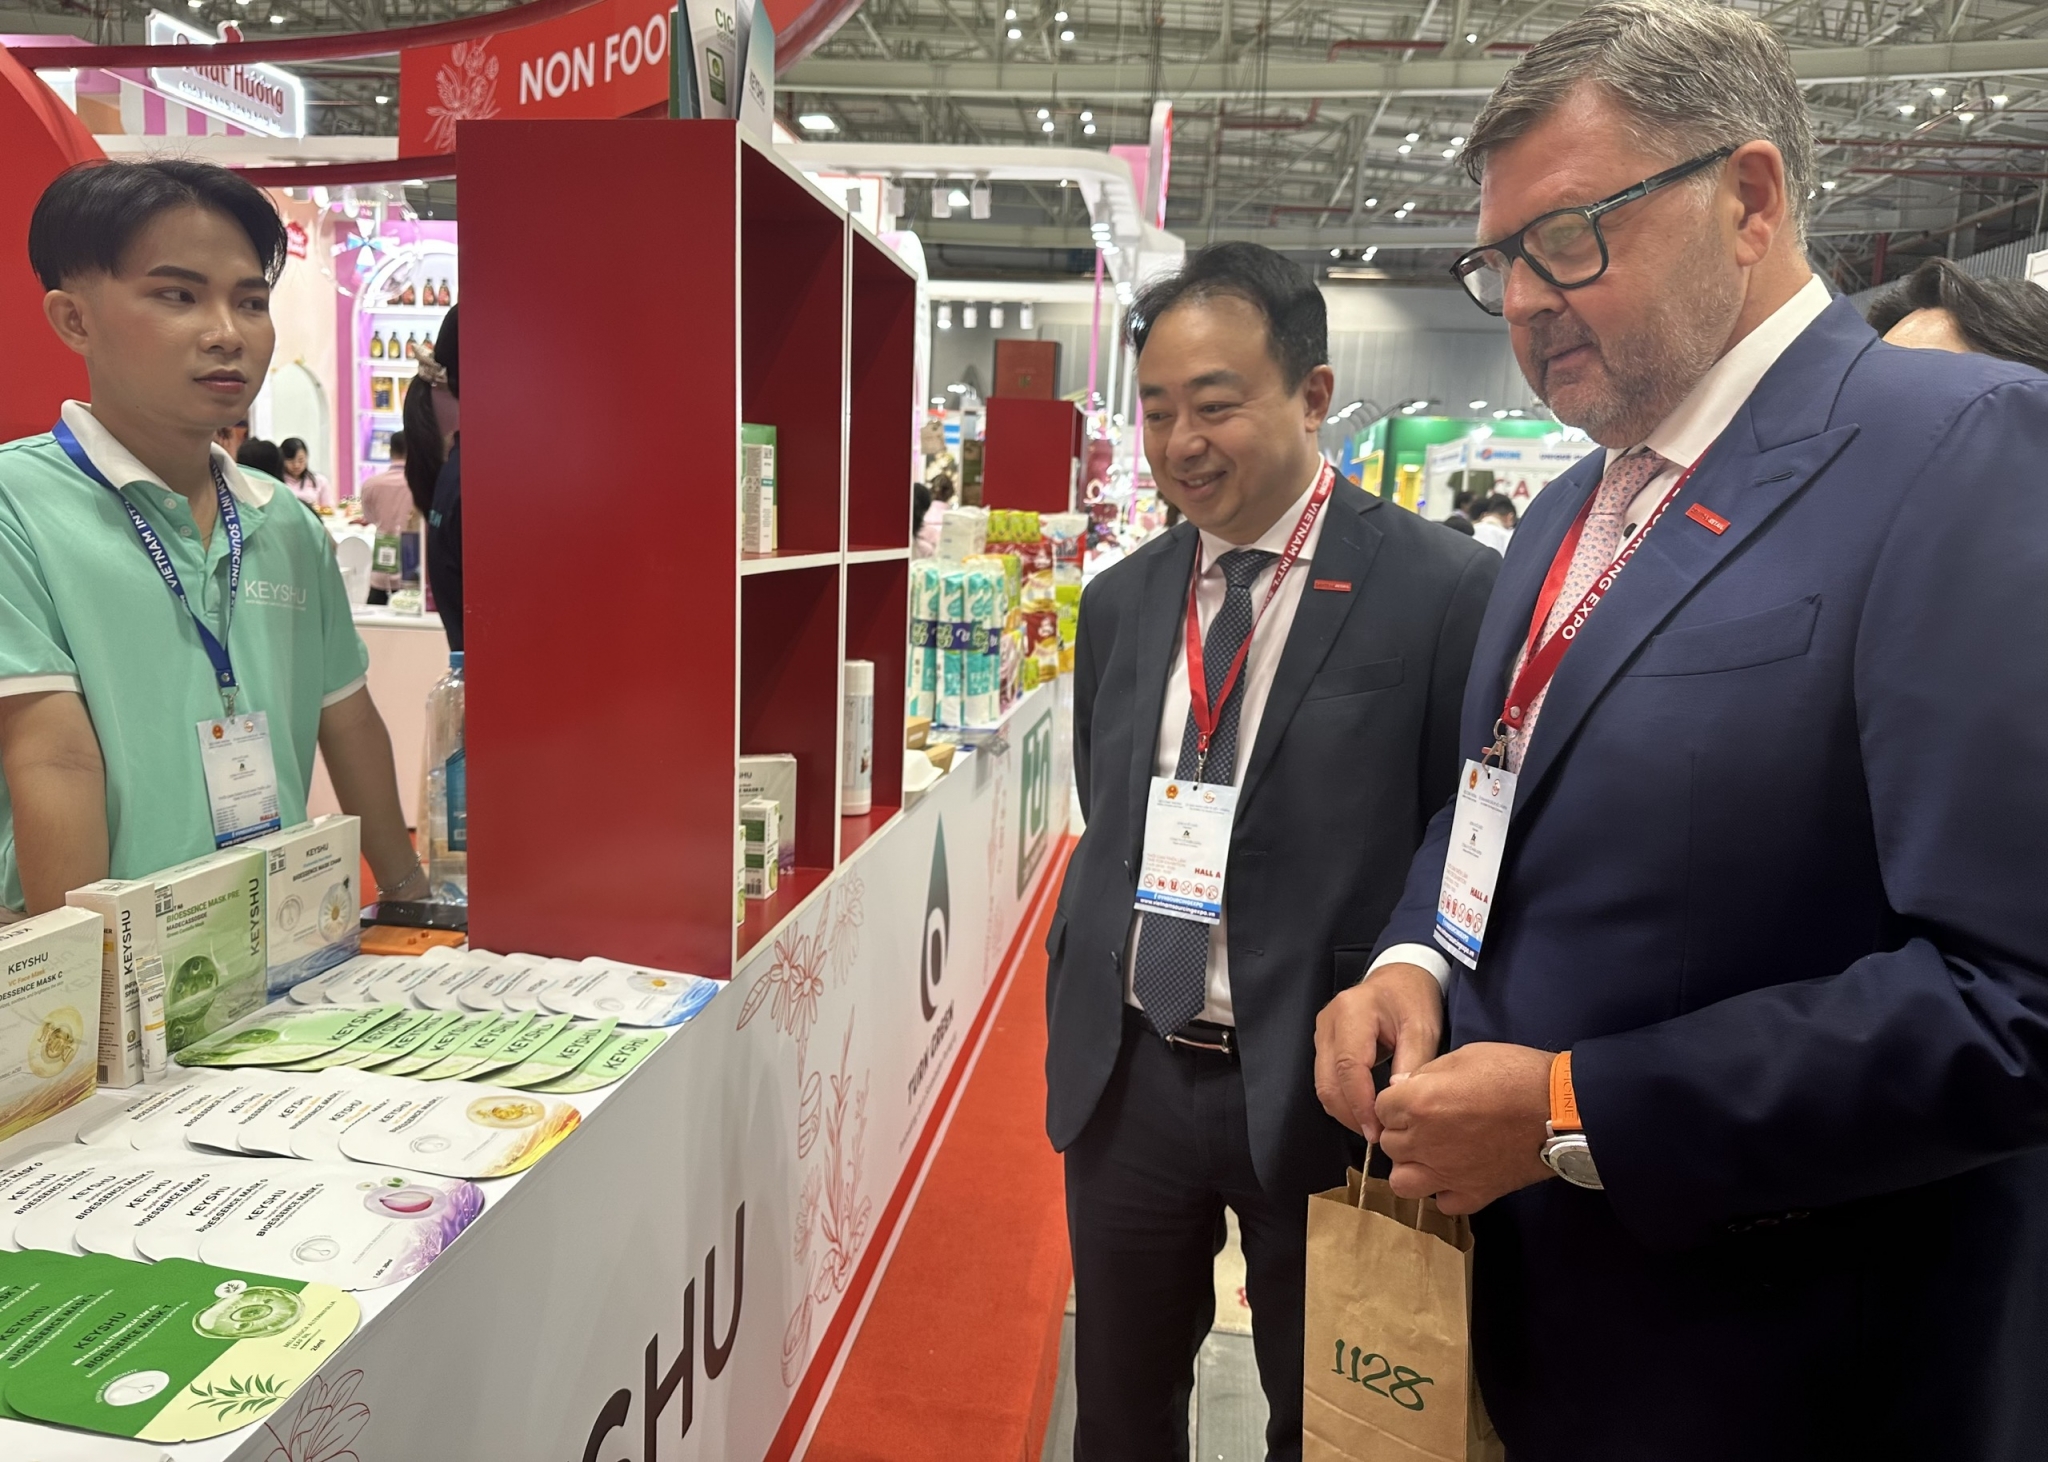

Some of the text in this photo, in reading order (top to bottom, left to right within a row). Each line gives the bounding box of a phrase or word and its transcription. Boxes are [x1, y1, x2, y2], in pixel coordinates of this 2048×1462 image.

[519, 13, 670, 105] NON FOO
[1287, 502, 1320, 557] VIETNAM
[142, 530, 178, 588] VIETNAM
[228, 523, 241, 587] SOURCING
[244, 580, 306, 604] KEYSHU
[1561, 593, 1601, 640] EXPO
[306, 843, 329, 857] KEYSHU
[1194, 867, 1213, 877] HALL
[166, 901, 207, 923] BIOESSENCE
[207, 894, 227, 908] MASK
[227, 889, 240, 901] PRE
[1470, 886, 1489, 904] HALL A
[249, 877, 260, 956] KEYSHU
[121, 909, 133, 976] KEYSHU
[8, 952, 49, 975] KEYSHU
[36, 973, 56, 988] MASK
[57, 970, 63, 979] C
[327, 1008, 384, 1041] KEYSHU
[361, 1017, 413, 1044] KEYSHU
[430, 1020, 482, 1052] KEYSHU
[470, 1019, 520, 1050] KEYSHU
[503, 1023, 554, 1053] KEYSHU
[556, 1027, 601, 1059] KEYSHU
[603, 1037, 649, 1070] KEYSHU
[131, 1096, 171, 1120] BIOESSENCE
[184, 1100, 221, 1127] BIOESSENCE
[228, 1092, 264, 1114] KEYSHU
[238, 1097, 273, 1125] BIOESSENCE
[279, 1095, 313, 1119] KEYSHU
[289, 1102, 323, 1130] BIOESSENCE
[322, 1092, 338, 1107] MASK
[328, 1099, 363, 1122] KEYSHU
[378, 1101, 413, 1123] KEYSHU
[423, 1098, 438, 1110] MASK
[7, 1173, 56, 1201] KEYSHU
[11, 1165, 35, 1179] MASK
[68, 1175, 117, 1201] KEYSHU
[14, 1170, 86, 1215] BIOESSENCE MASK
[75, 1185, 126, 1220] BIOESSENCE
[124, 1173, 148, 1188] MASK
[125, 1179, 172, 1209] KEYSHU
[134, 1191, 183, 1227] BIOESSENCE
[181, 1177, 203, 1194] MASK
[185, 1186, 231, 1217] KEYSHU
[195, 1197, 240, 1233] BIOESSENCE
[238, 1182, 261, 1200] MASK
[244, 1189, 287, 1221] KEYSHU
[256, 1201, 296, 1237] BIOESSENCE
[294, 1187, 317, 1206] MASK
[0, 1305, 50, 1342] KEYSHU
[7, 1317, 65, 1362] BIOESSENCE
[63, 1298, 88, 1318] MASK
[73, 1311, 127, 1350] KEYSHU
[83, 1329, 141, 1369] BIOESSENCE
[139, 1311, 164, 1330] MASK
[115, 1350, 127, 1359] and
[125, 1339, 139, 1352] helps
[1331, 1338, 1434, 1411] 1128
